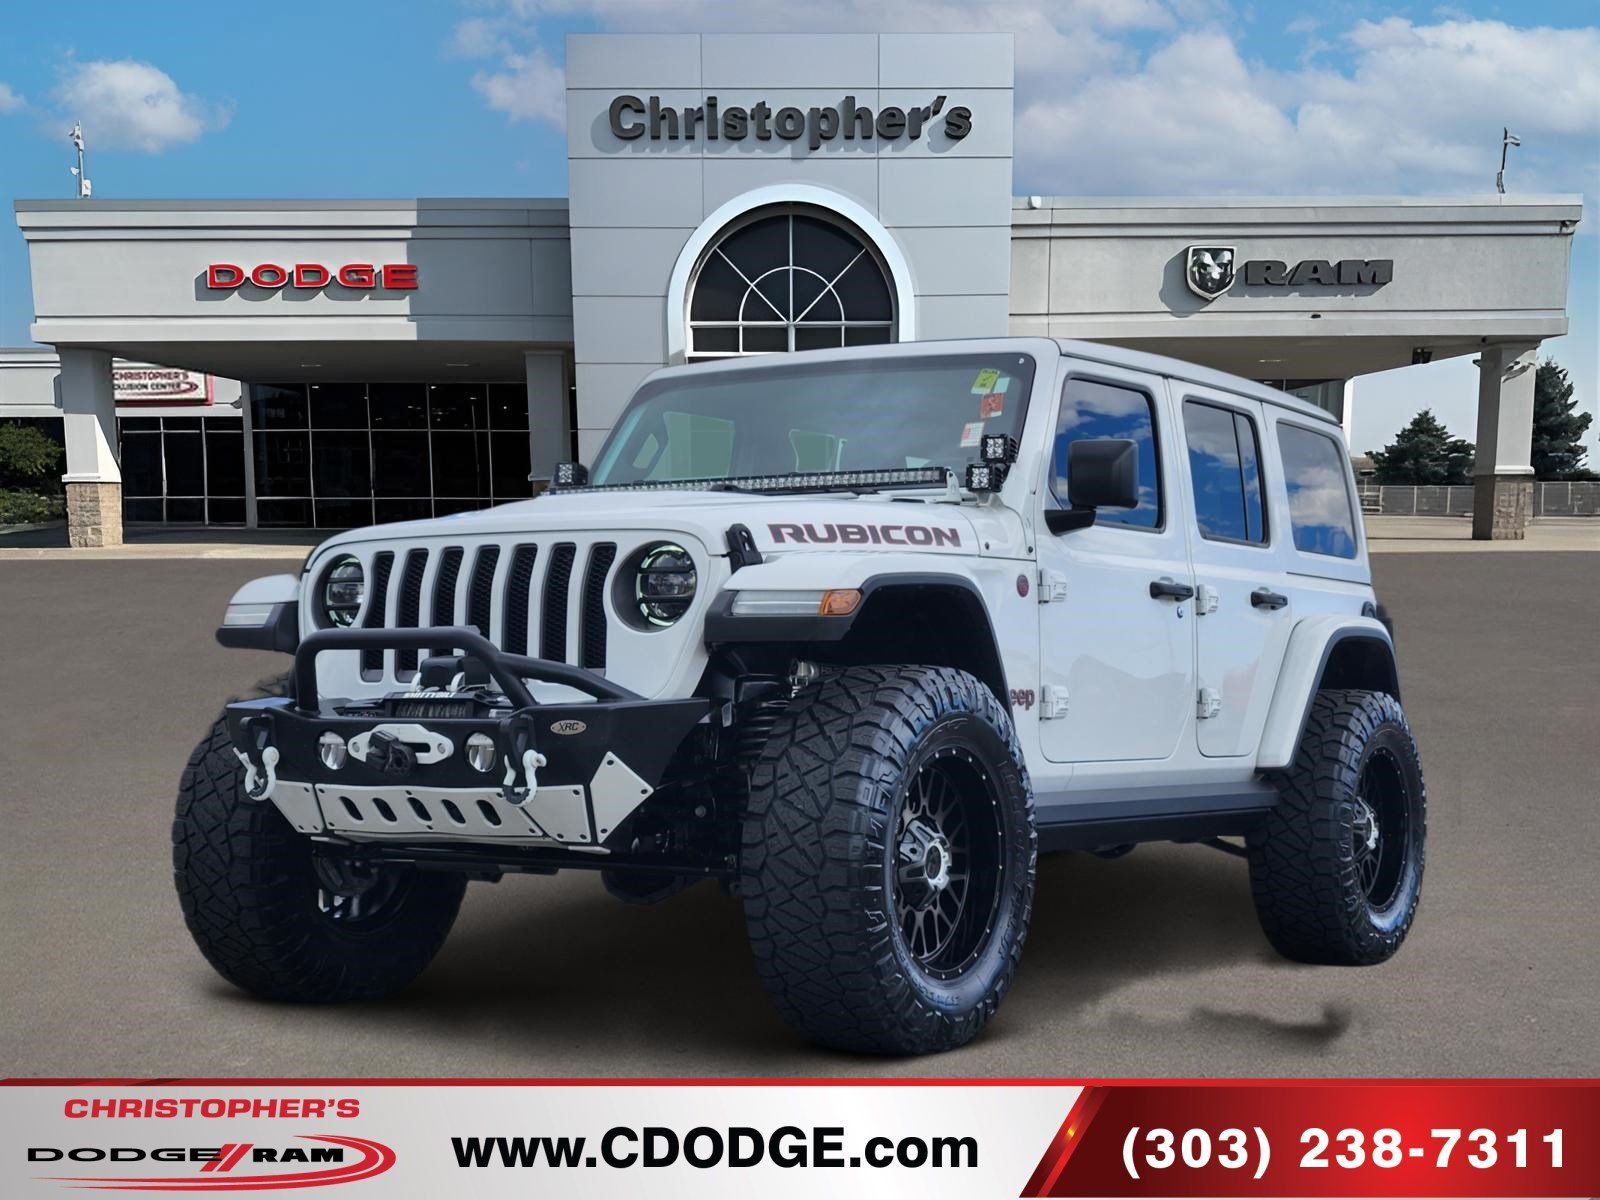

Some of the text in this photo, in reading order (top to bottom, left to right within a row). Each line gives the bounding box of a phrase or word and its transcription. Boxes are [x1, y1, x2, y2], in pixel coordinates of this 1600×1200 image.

[608, 94, 973, 150] Christopher's
[206, 263, 419, 289] DODGE
[1244, 259, 1394, 286] RAM
[113, 382, 149, 391] OLLISION
[767, 523, 962, 548] RUBICON
[1009, 688, 1036, 711] eep
